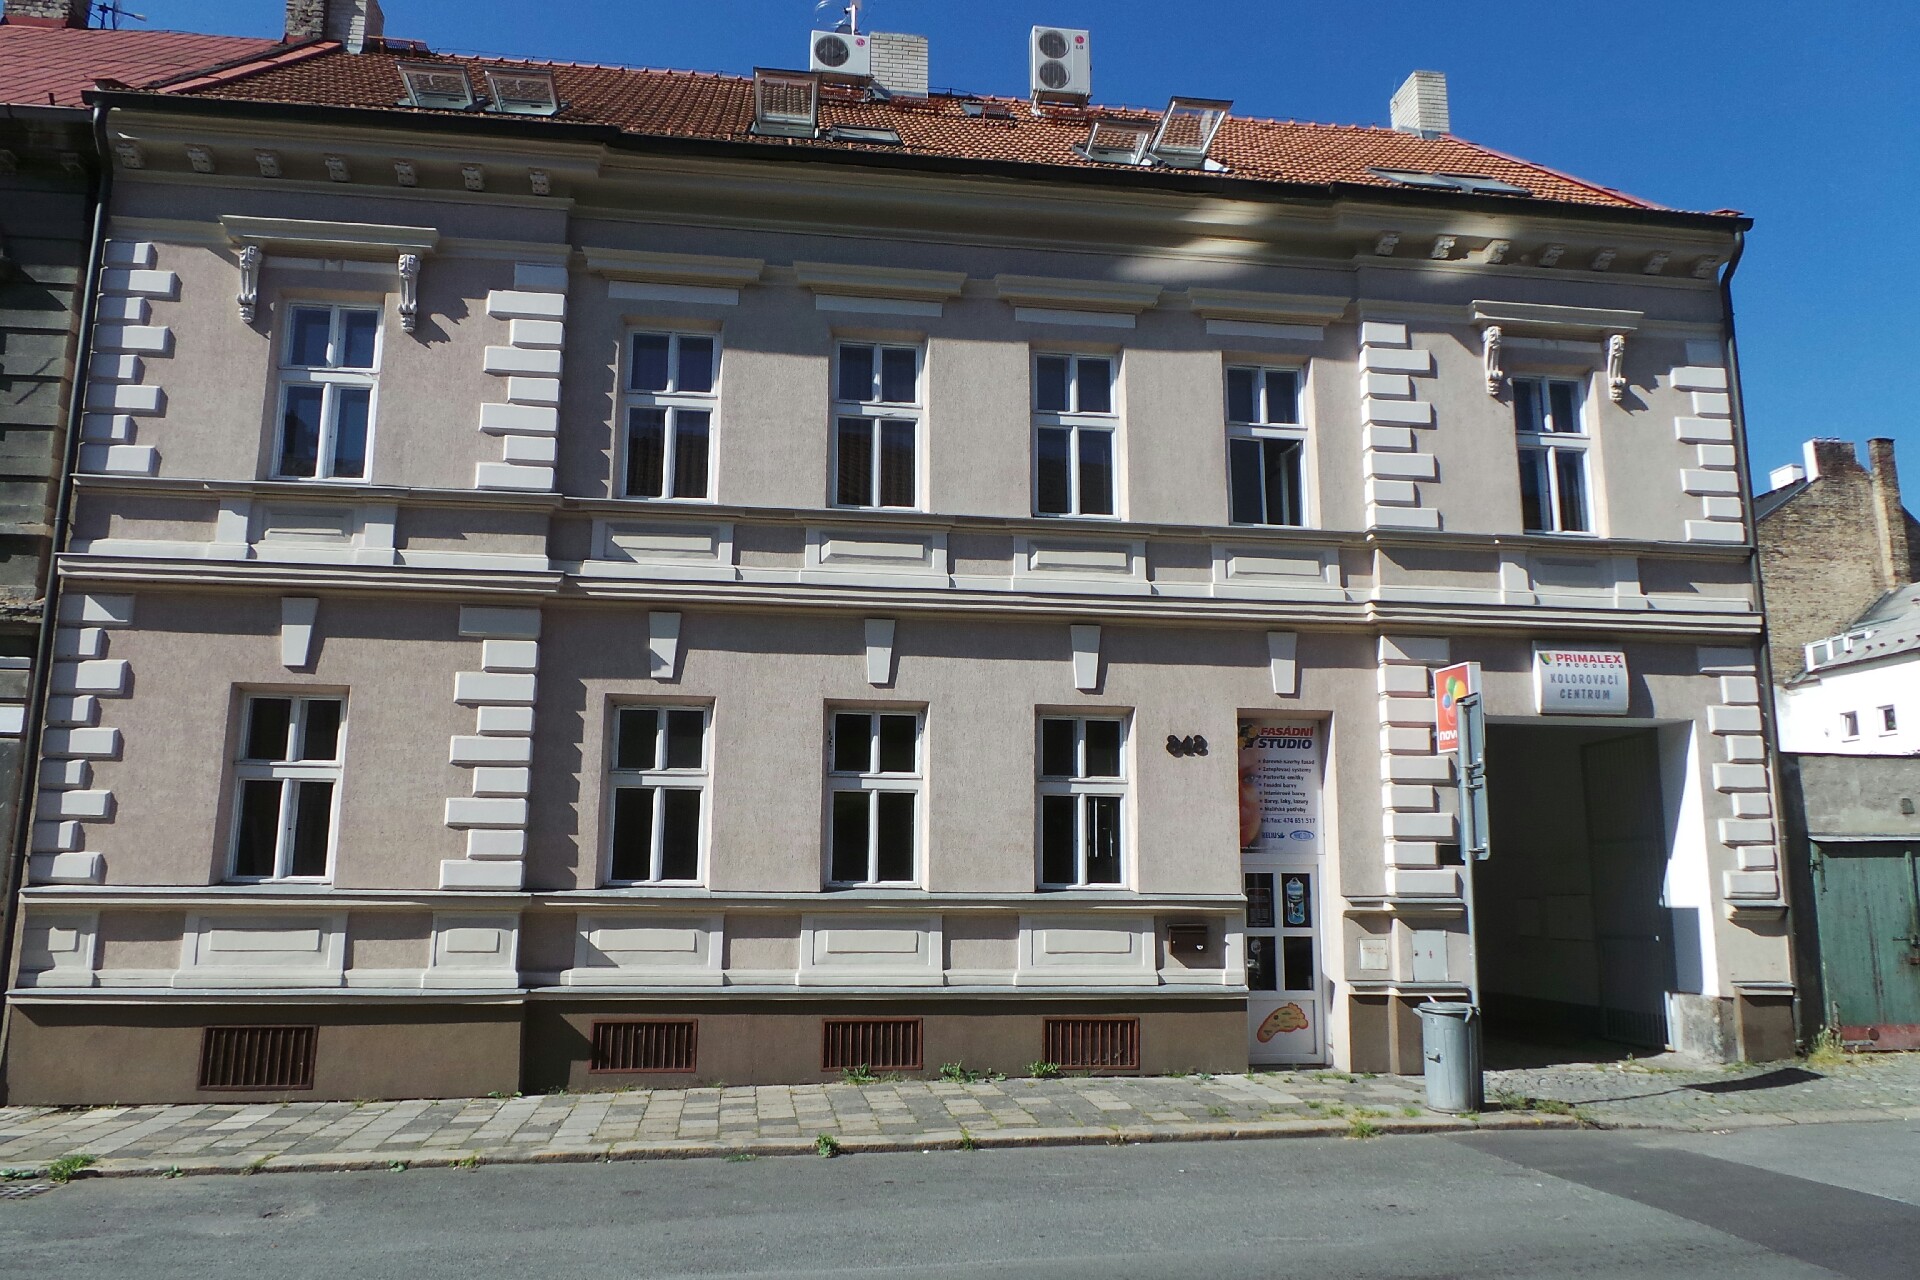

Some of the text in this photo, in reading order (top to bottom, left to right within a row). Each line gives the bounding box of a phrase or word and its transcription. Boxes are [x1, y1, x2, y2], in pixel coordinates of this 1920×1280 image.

[1555, 653, 1622, 664] PRIMALEX
[1550, 673, 1619, 685] KOLOROVACÍ
[1559, 689, 1610, 700] CENTRUM
[1261, 726, 1314, 736] FASÁDNÍ
[1440, 729, 1458, 741] nov
[1258, 738, 1313, 749] STUDIO
